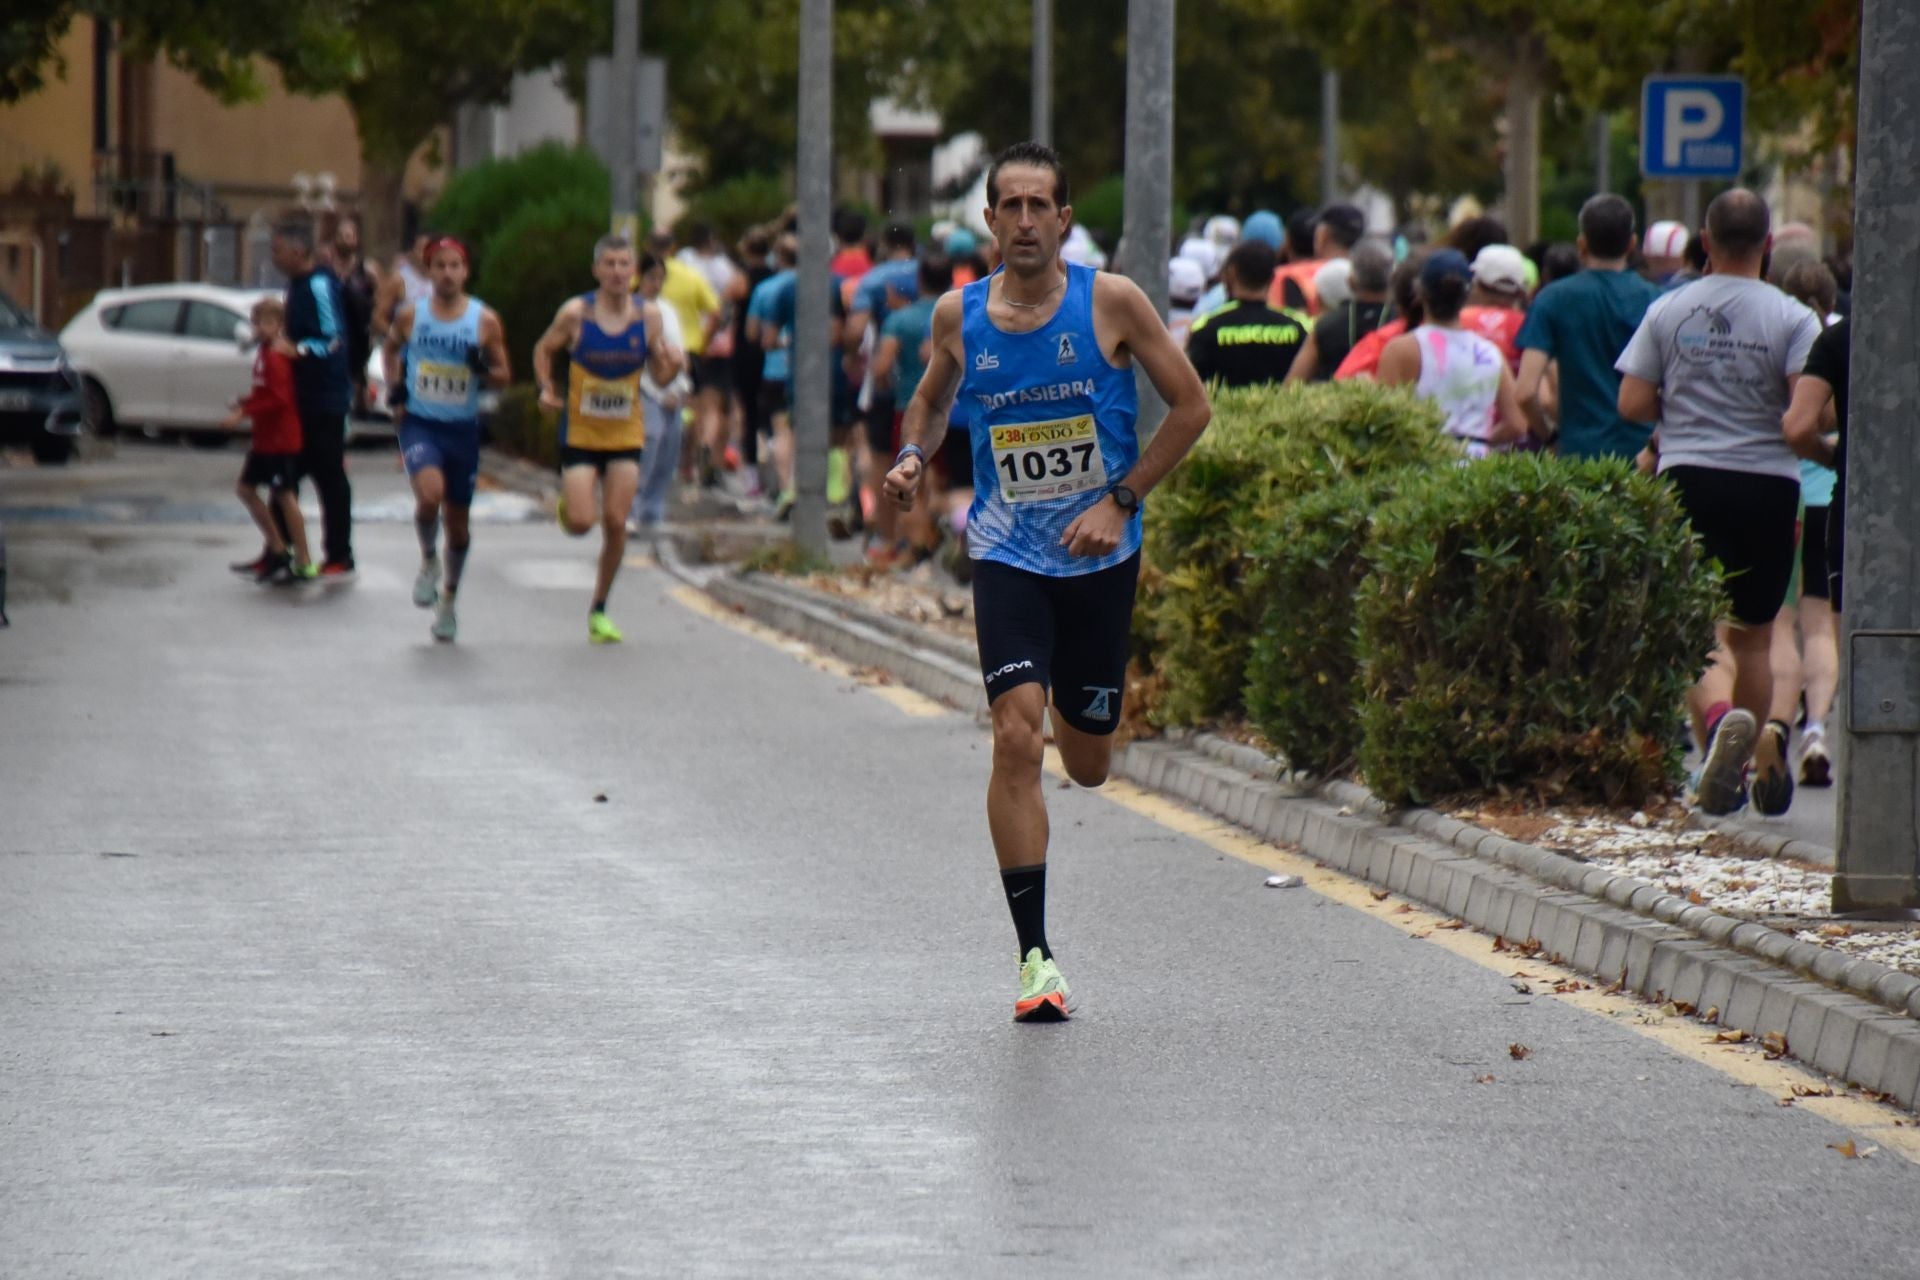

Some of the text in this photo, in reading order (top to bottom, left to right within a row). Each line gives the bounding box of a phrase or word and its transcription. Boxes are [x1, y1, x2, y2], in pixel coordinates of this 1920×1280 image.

[1663, 89, 1724, 168] P
[1005, 429, 1021, 443] 38
[1000, 442, 1096, 482] 1037
